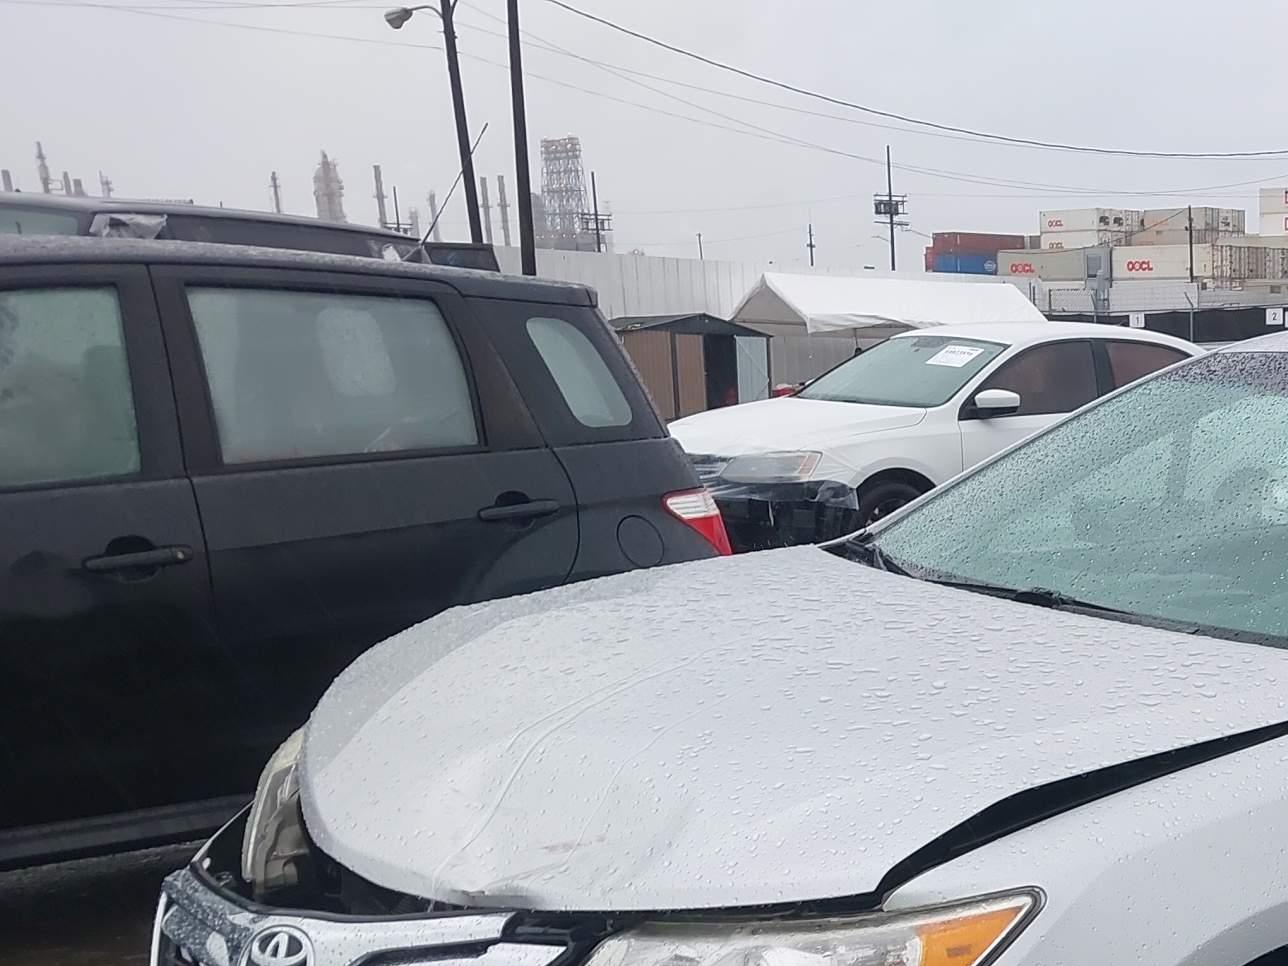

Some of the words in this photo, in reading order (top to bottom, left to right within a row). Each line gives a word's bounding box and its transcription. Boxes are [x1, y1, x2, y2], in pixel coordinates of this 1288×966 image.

[1010, 263, 1035, 273] OOCL
[1126, 260, 1153, 271] OOCL
[1272, 312, 1278, 321] 2
